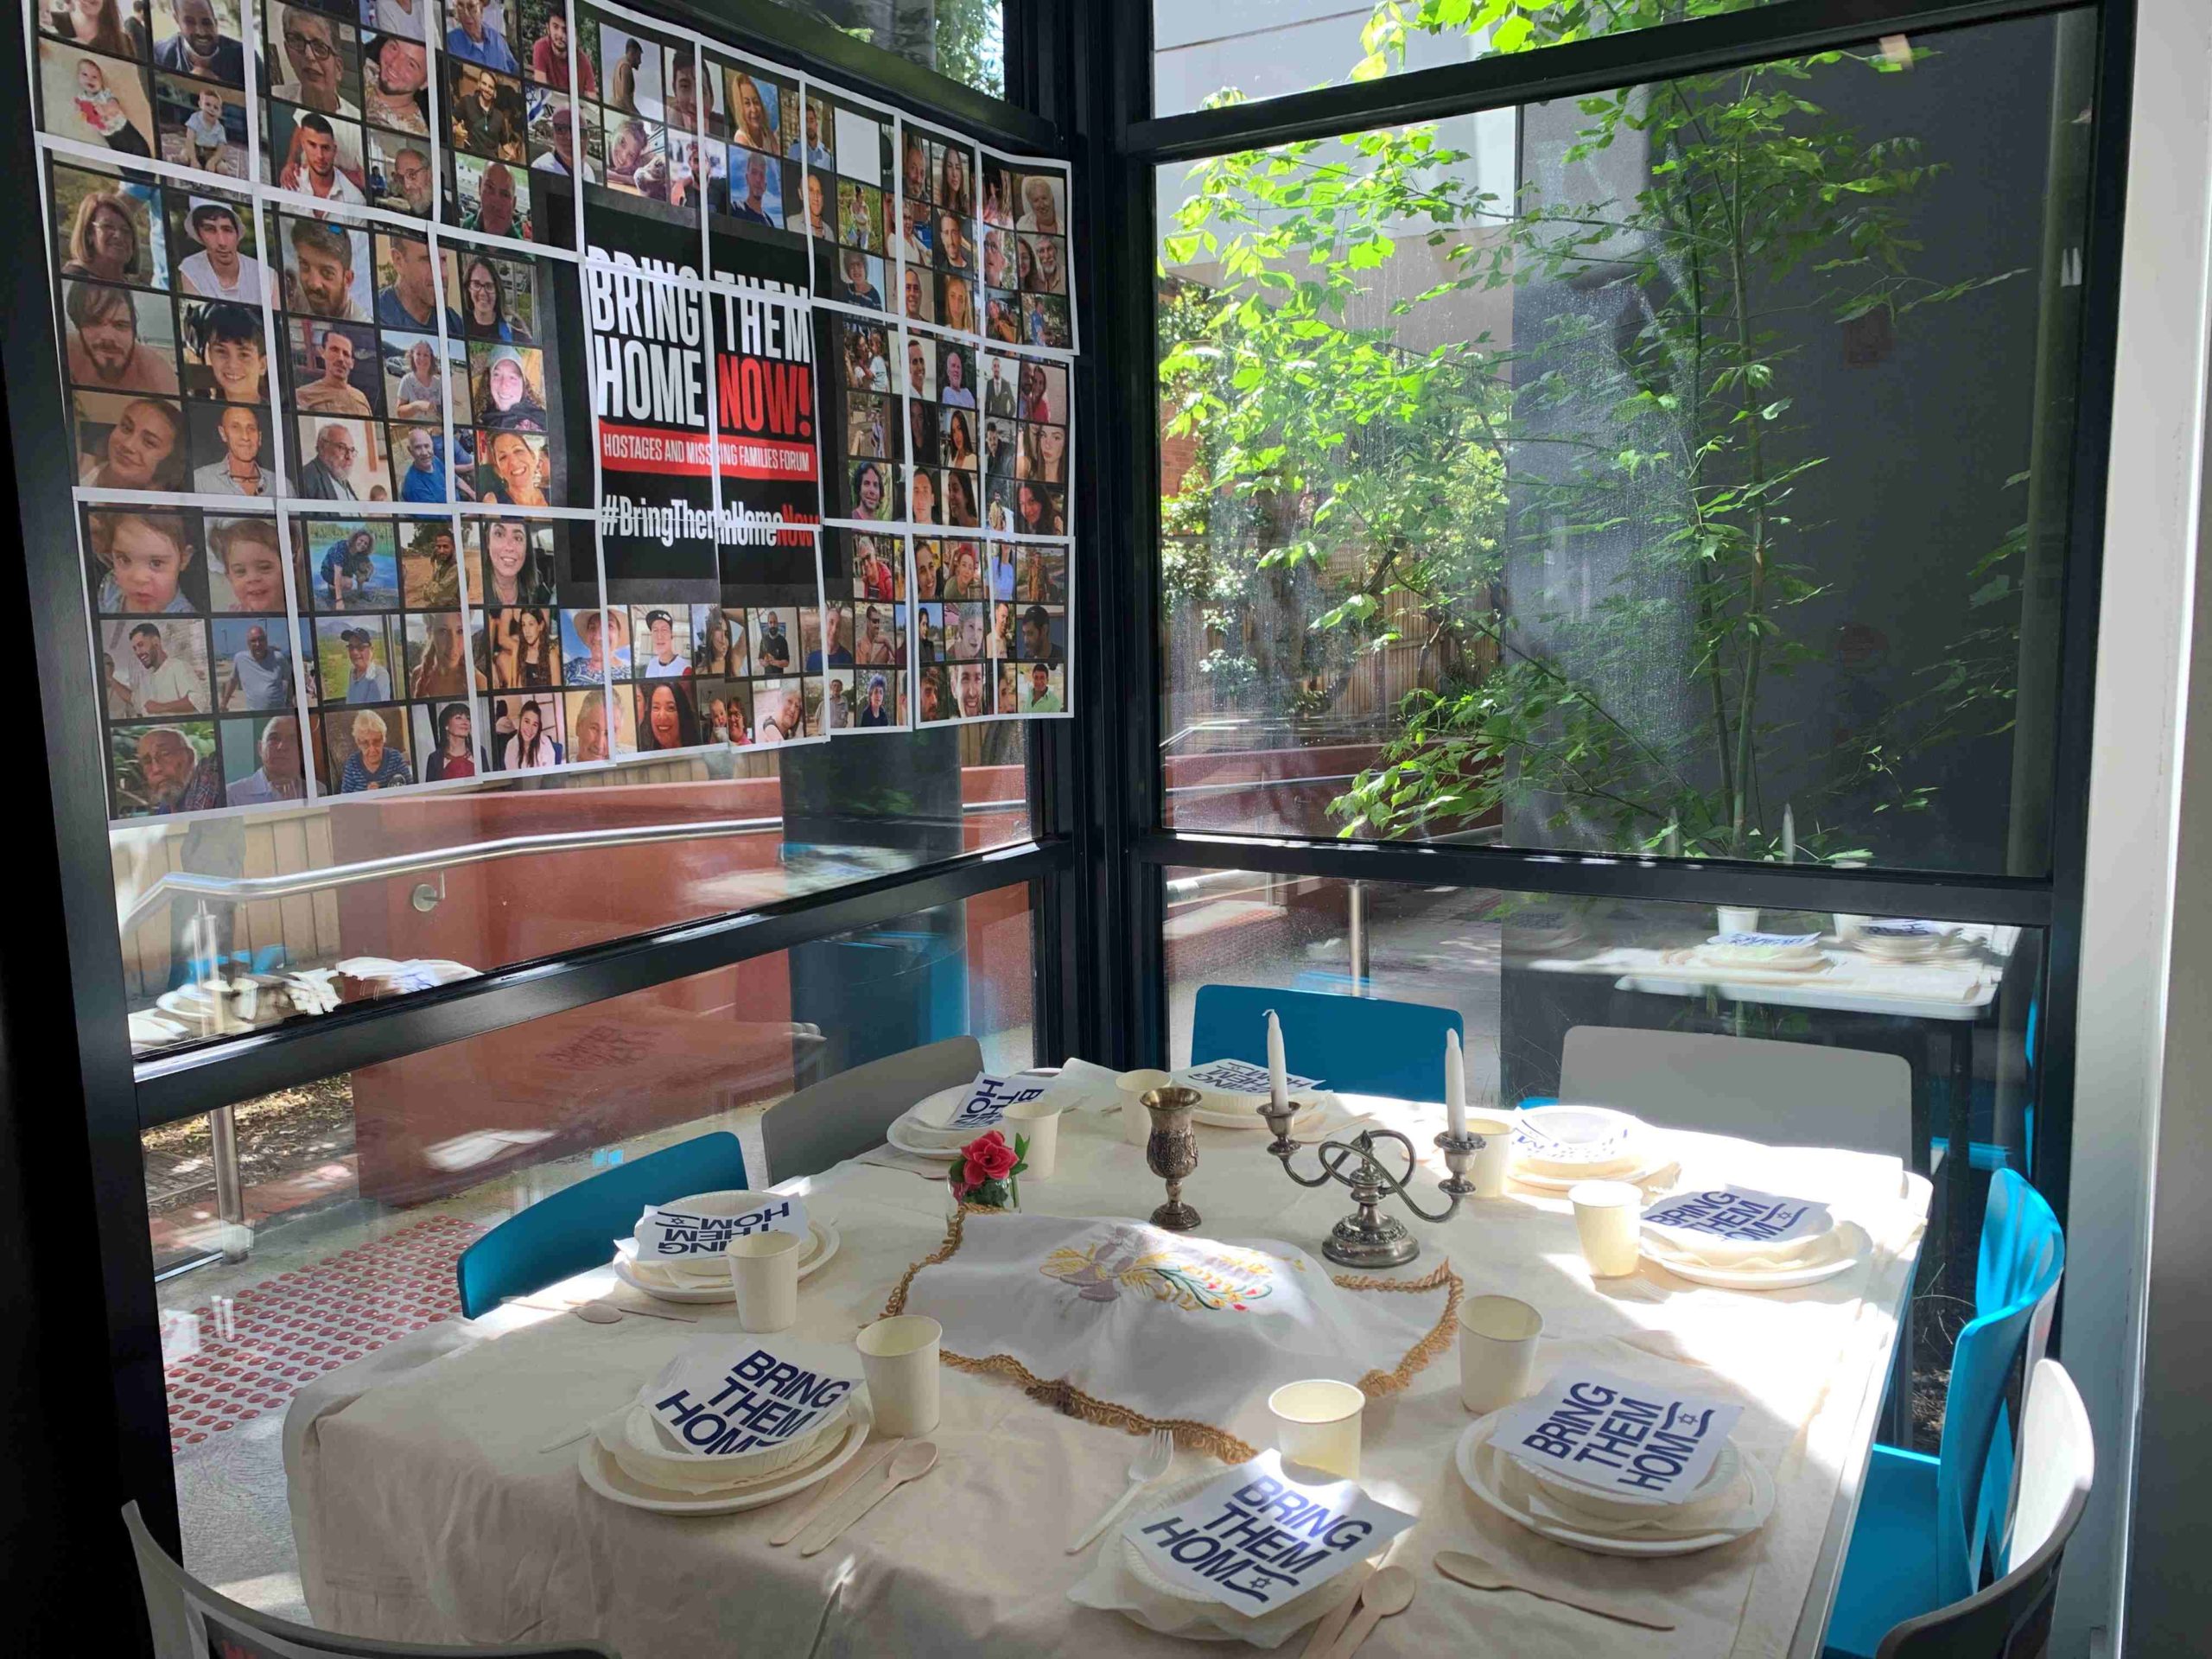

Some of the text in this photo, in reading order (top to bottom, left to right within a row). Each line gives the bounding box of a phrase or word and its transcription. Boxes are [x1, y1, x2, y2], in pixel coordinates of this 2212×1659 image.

[588, 245, 810, 363] BRING THEM
[594, 334, 812, 437] HOME NOW!
[603, 434, 810, 472] HOSTAGES AND MISSING FAMILIES FORUM
[1643, 1192, 1740, 1226] BRING
[658, 1241, 731, 1254] ING
[708, 1376, 817, 1438] THEM
[731, 1350, 850, 1408] BRING
[1522, 1382, 1618, 1459] BRING
[1573, 1397, 1664, 1469] THEM
[1204, 1502, 1332, 1573] THEM
[1233, 1475, 1372, 1552] BRING
